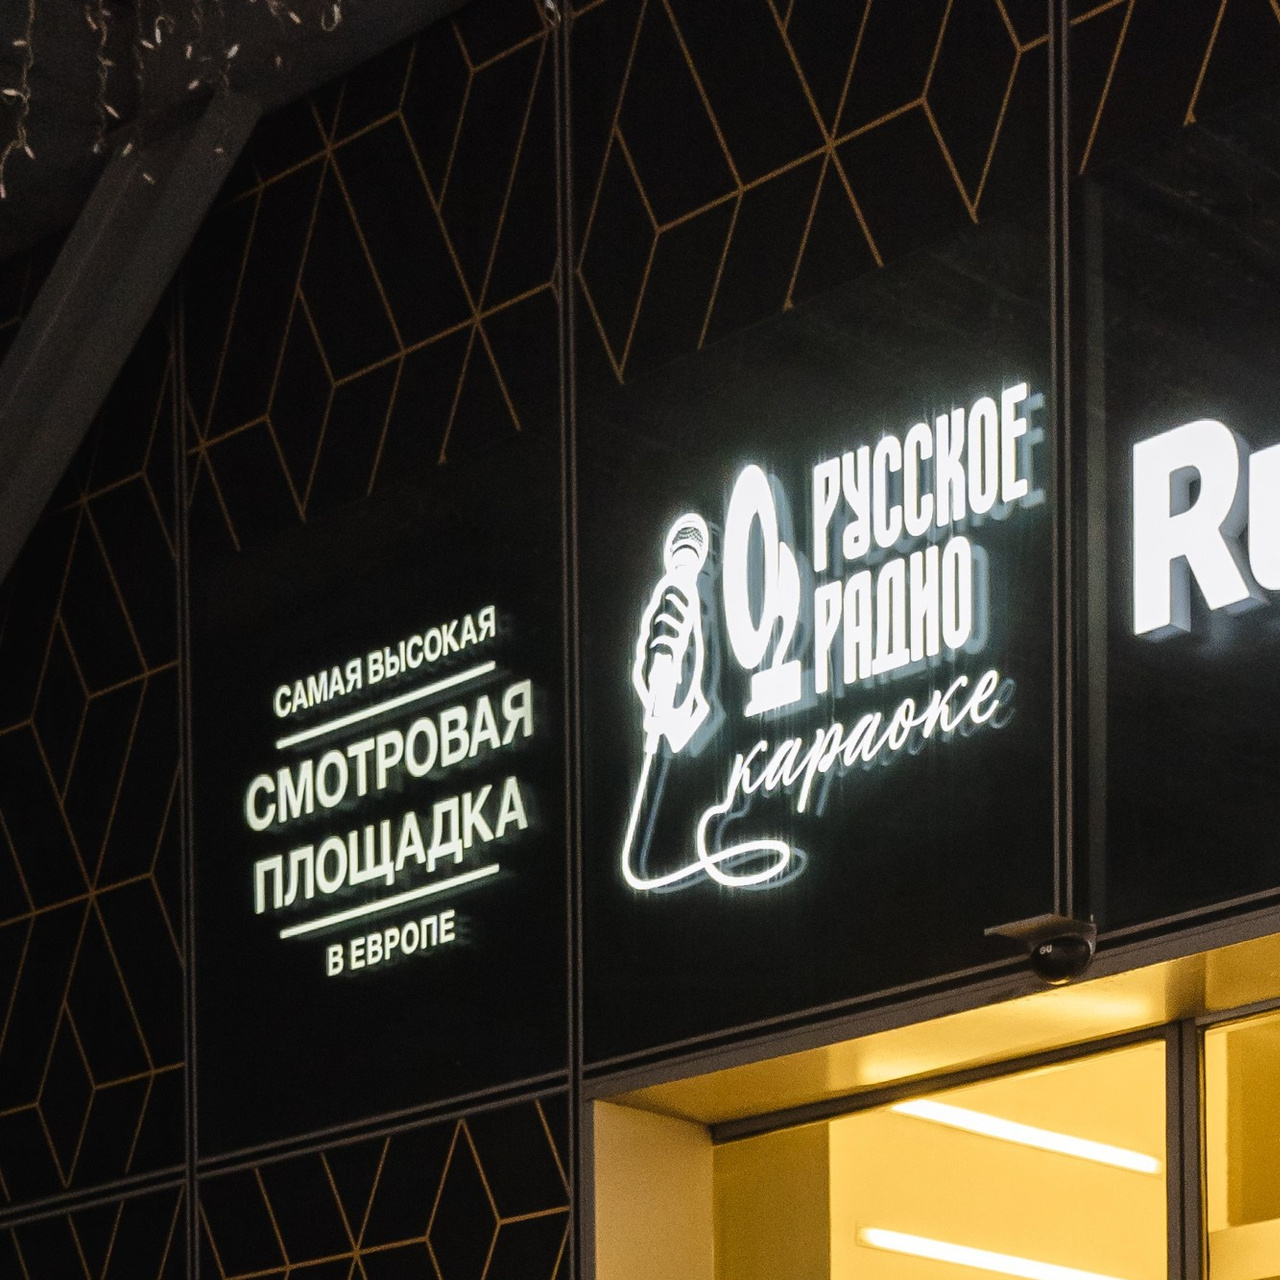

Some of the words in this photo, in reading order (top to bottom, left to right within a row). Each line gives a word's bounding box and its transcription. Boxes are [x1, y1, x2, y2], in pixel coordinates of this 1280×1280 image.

[813, 381, 1029, 573] РУССКОЕ
[273, 657, 362, 718] САМАЯ
[367, 604, 497, 685] ВЫСОКАЯ
[813, 535, 973, 695] РАДИО
[244, 678, 535, 832] СМОТРОВАЯ
[724, 669, 1000, 813] караоке
[253, 774, 529, 915] ПЛОЩАДКА
[325, 943, 345, 978] В
[349, 908, 457, 971] ЕВРОПЕ
